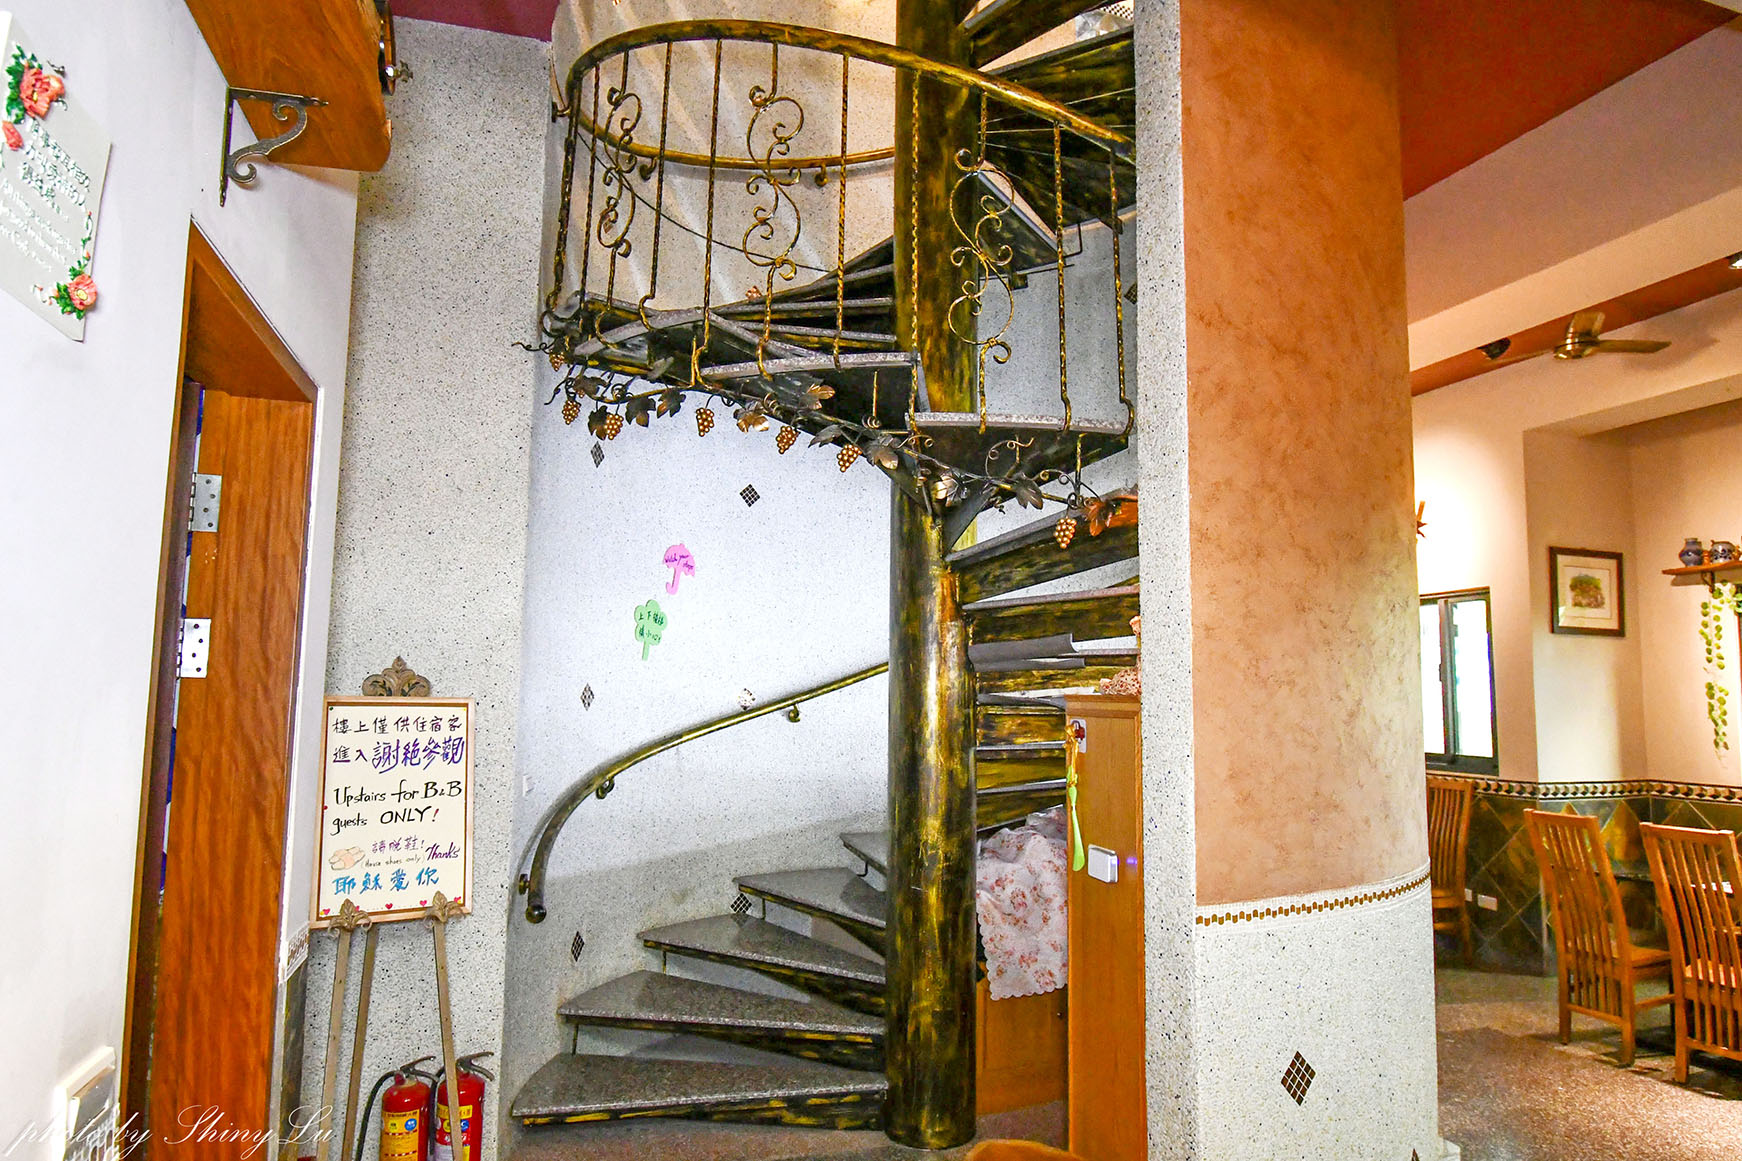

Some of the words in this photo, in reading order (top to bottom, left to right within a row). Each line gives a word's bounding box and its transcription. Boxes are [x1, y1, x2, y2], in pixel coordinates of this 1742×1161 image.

[333, 785, 386, 807] Upstairs
[391, 778, 419, 803] for
[330, 812, 367, 836] guests
[380, 805, 440, 825] ONLY!
[425, 841, 461, 861] Thanks
